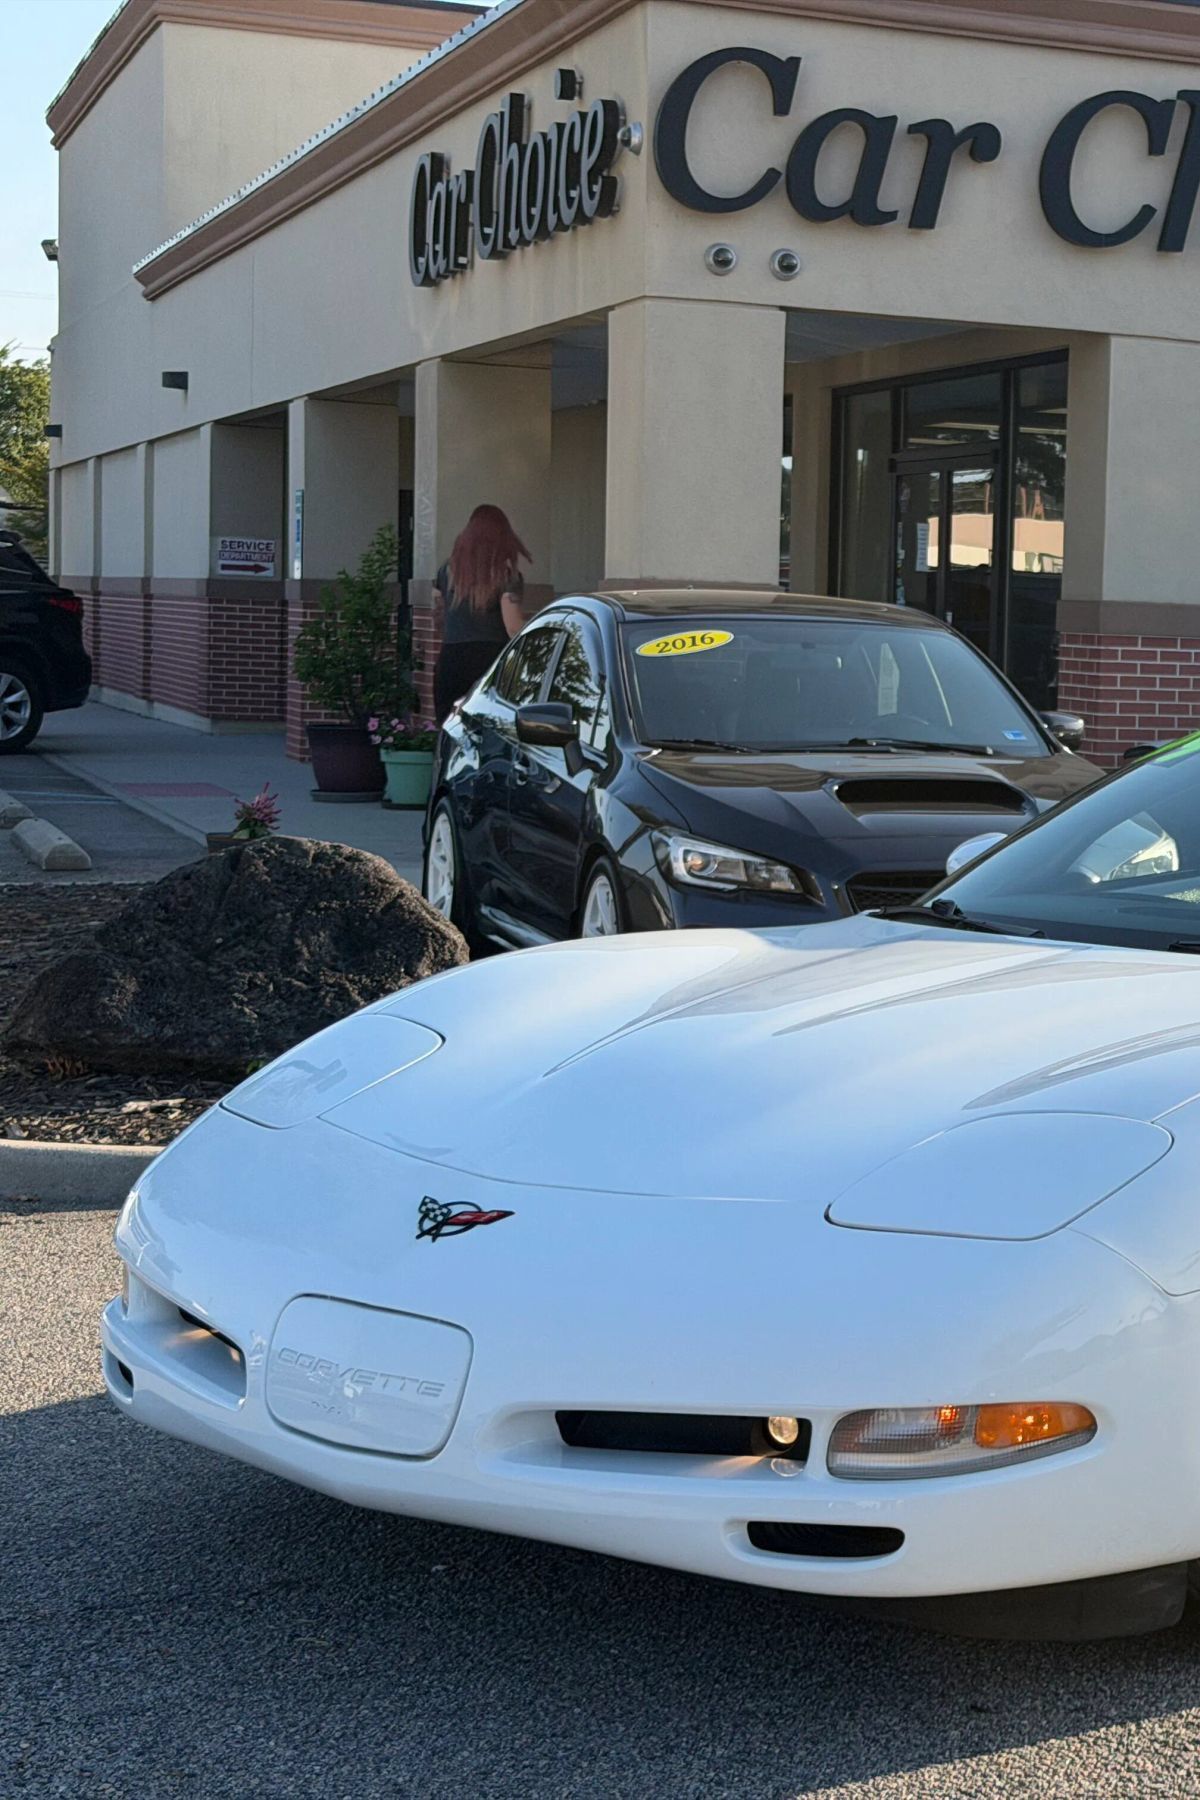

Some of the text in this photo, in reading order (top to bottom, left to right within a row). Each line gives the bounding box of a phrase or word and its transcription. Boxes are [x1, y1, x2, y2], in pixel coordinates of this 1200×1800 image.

[655, 47, 1001, 230] Car
[409, 68, 620, 288] Car Choice
[220, 539, 273, 552] SERVICE
[656, 632, 714, 653] 2016
[278, 1347, 446, 1397] CORVETTE
